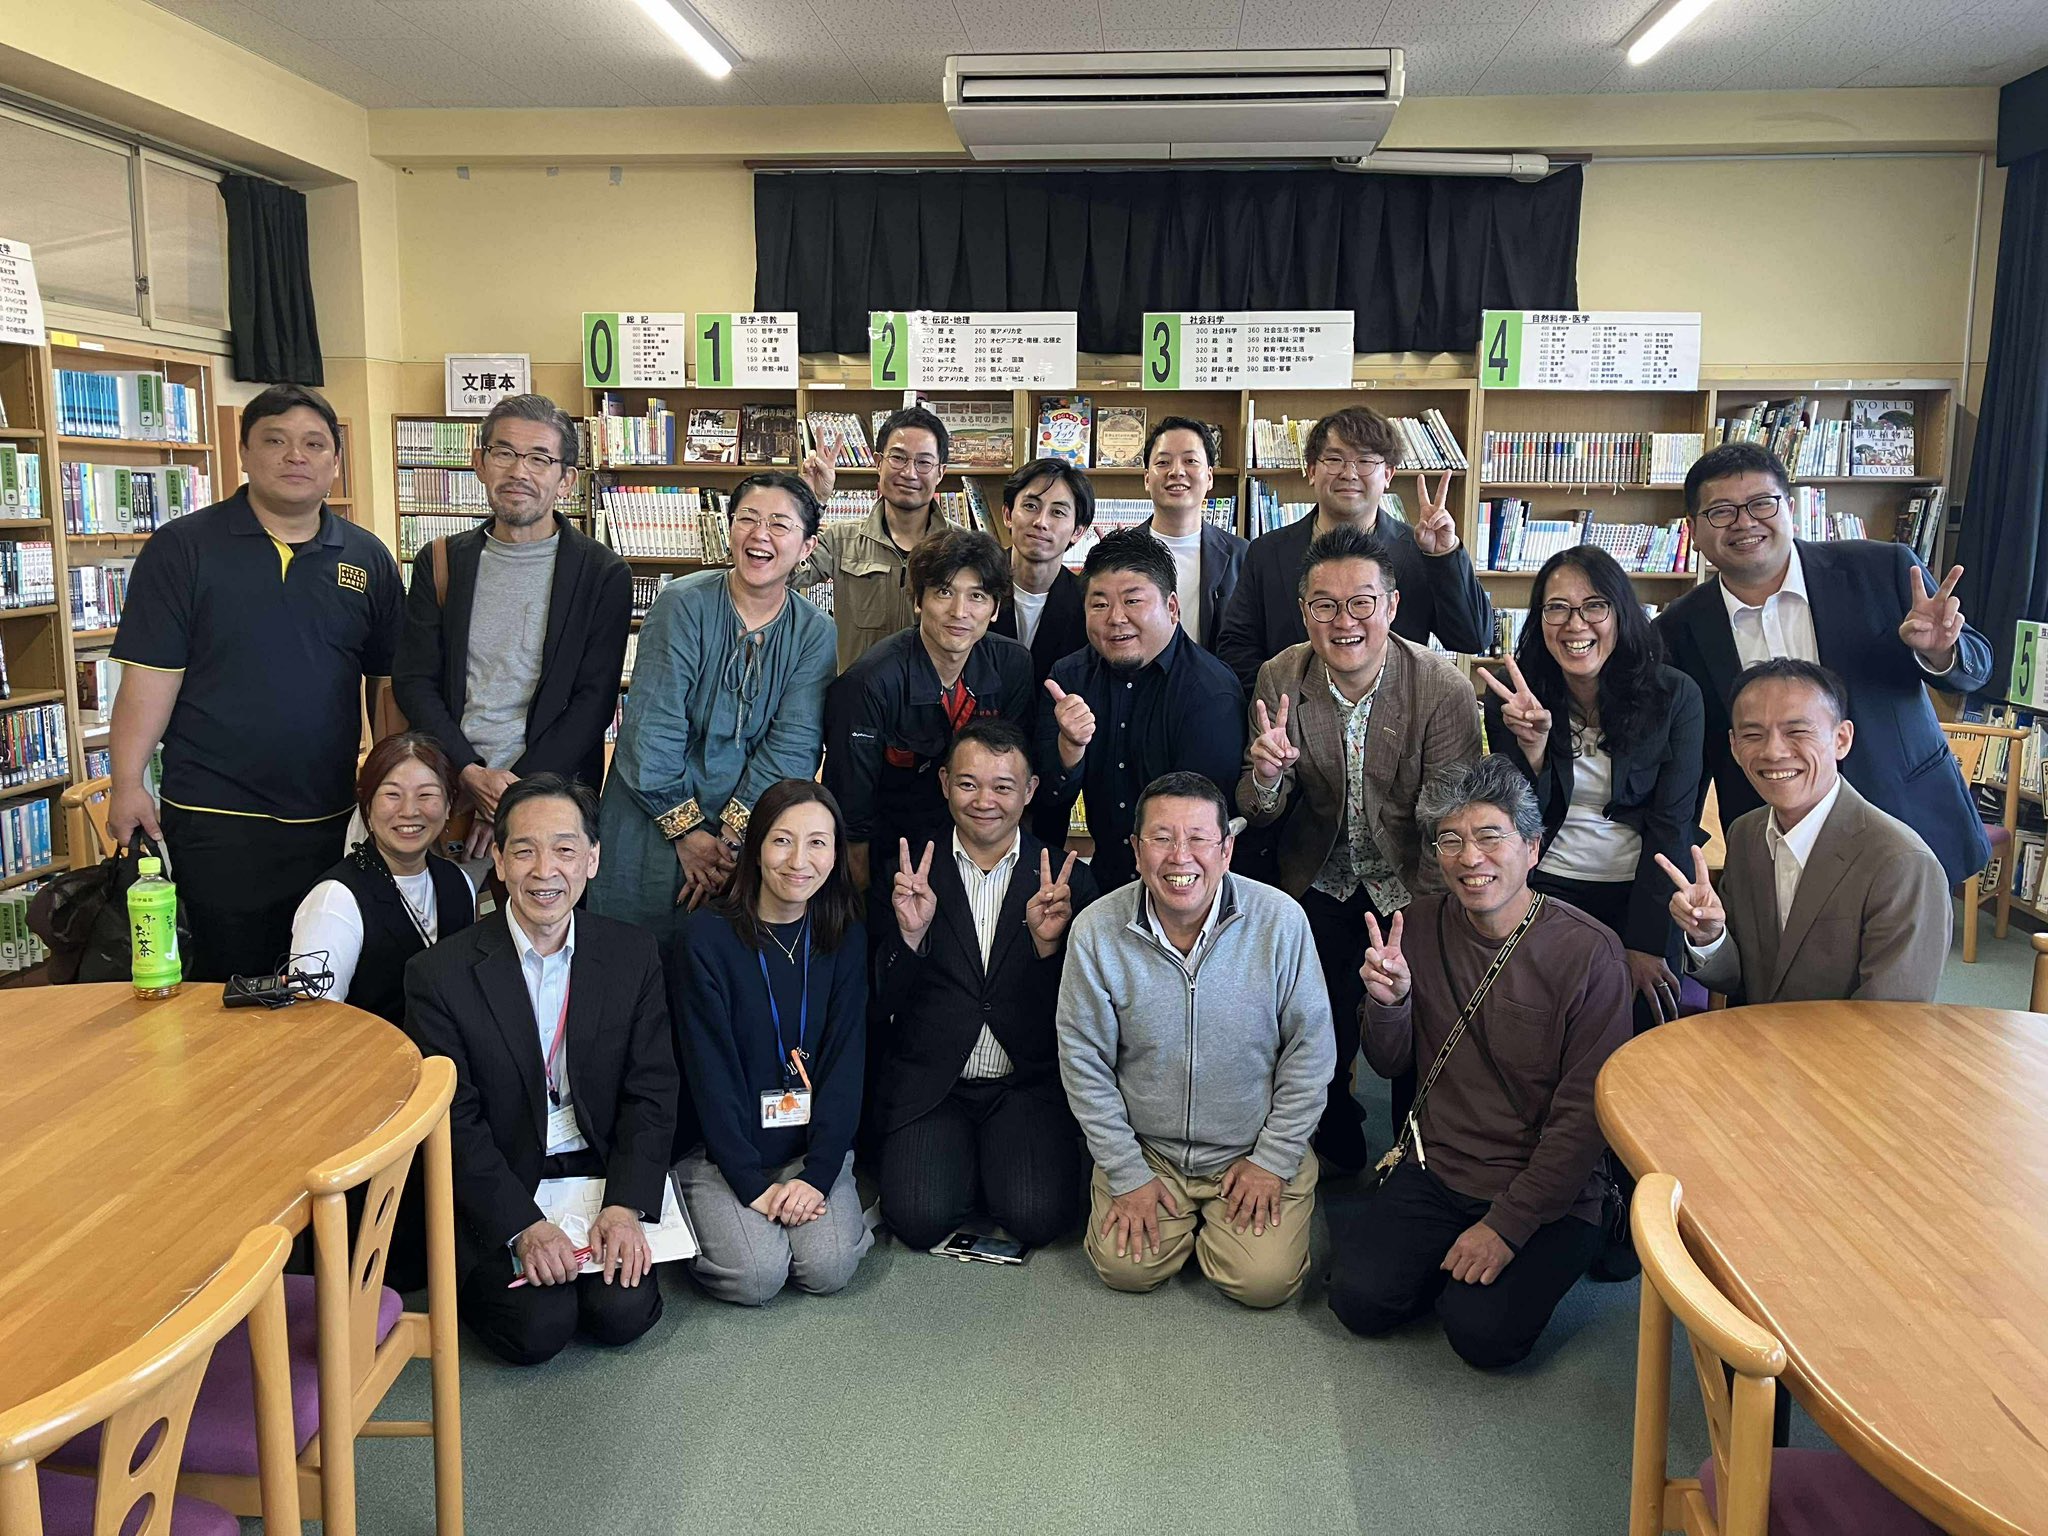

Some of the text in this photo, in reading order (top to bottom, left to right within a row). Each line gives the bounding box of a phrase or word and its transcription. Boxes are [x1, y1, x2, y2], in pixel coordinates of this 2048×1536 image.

[740, 315, 778, 325] 哲学・宗教
[1189, 315, 1225, 325] 社会科学
[1532, 314, 1590, 324] 自然科学・医学
[591, 319, 612, 383] 0
[704, 321, 721, 382] 1
[881, 320, 896, 381] 2
[1152, 321, 1171, 383] 3
[1488, 319, 1509, 382] 4
[462, 373, 515, 391] 文庫本
[464, 394, 492, 404] （新書）
[1855, 400, 1913, 410] WORLD
[960, 415, 1008, 424] ある町の歴史
[1855, 466, 1914, 475] FLOWERS
[120, 510, 127, 518] ヒ
[341, 566, 365, 577] PIZZA
[341, 571, 364, 583] LITTLE
[341, 577, 364, 589] PARTY
[2019, 630, 2033, 697] 5
